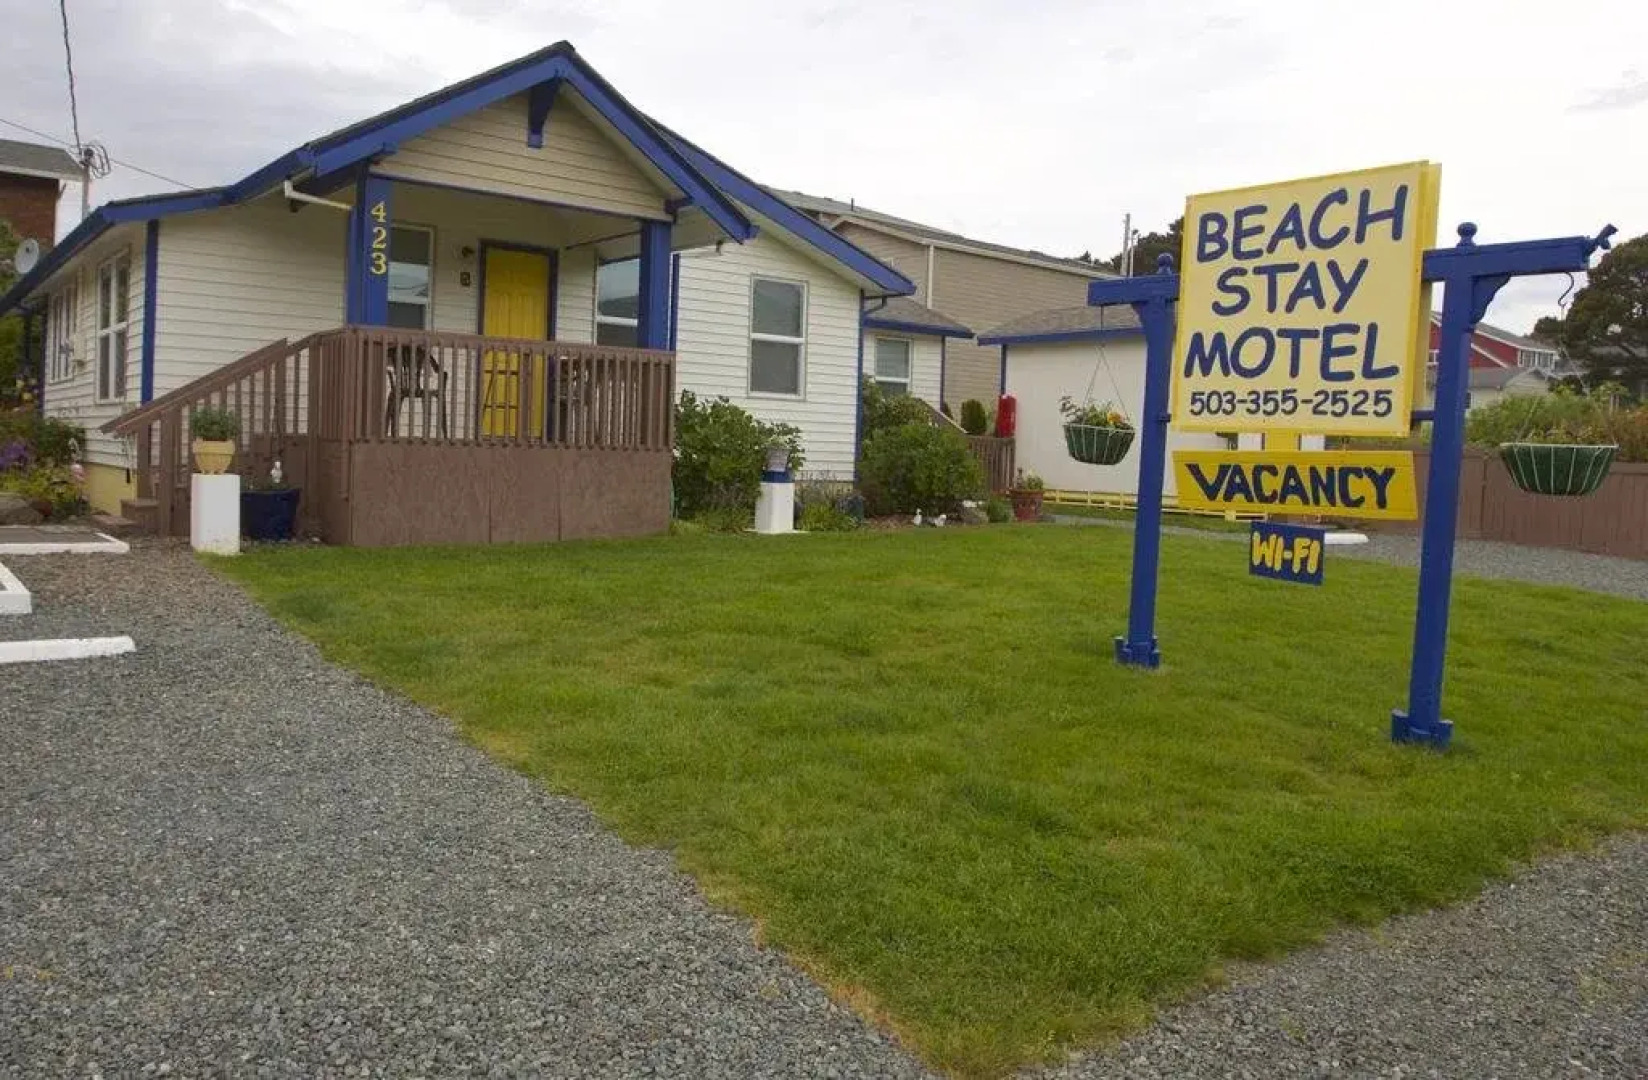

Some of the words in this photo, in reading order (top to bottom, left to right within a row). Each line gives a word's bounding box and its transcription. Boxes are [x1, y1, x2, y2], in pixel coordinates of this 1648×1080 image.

[370, 201, 387, 275] 423
[1197, 185, 1408, 263] BEACH
[1211, 258, 1369, 316] STAY
[1184, 322, 1399, 382] MOTEL
[1190, 389, 1393, 417] 503-355-2525
[1185, 463, 1396, 509] VACANCY
[1252, 531, 1320, 574] WI-FI
